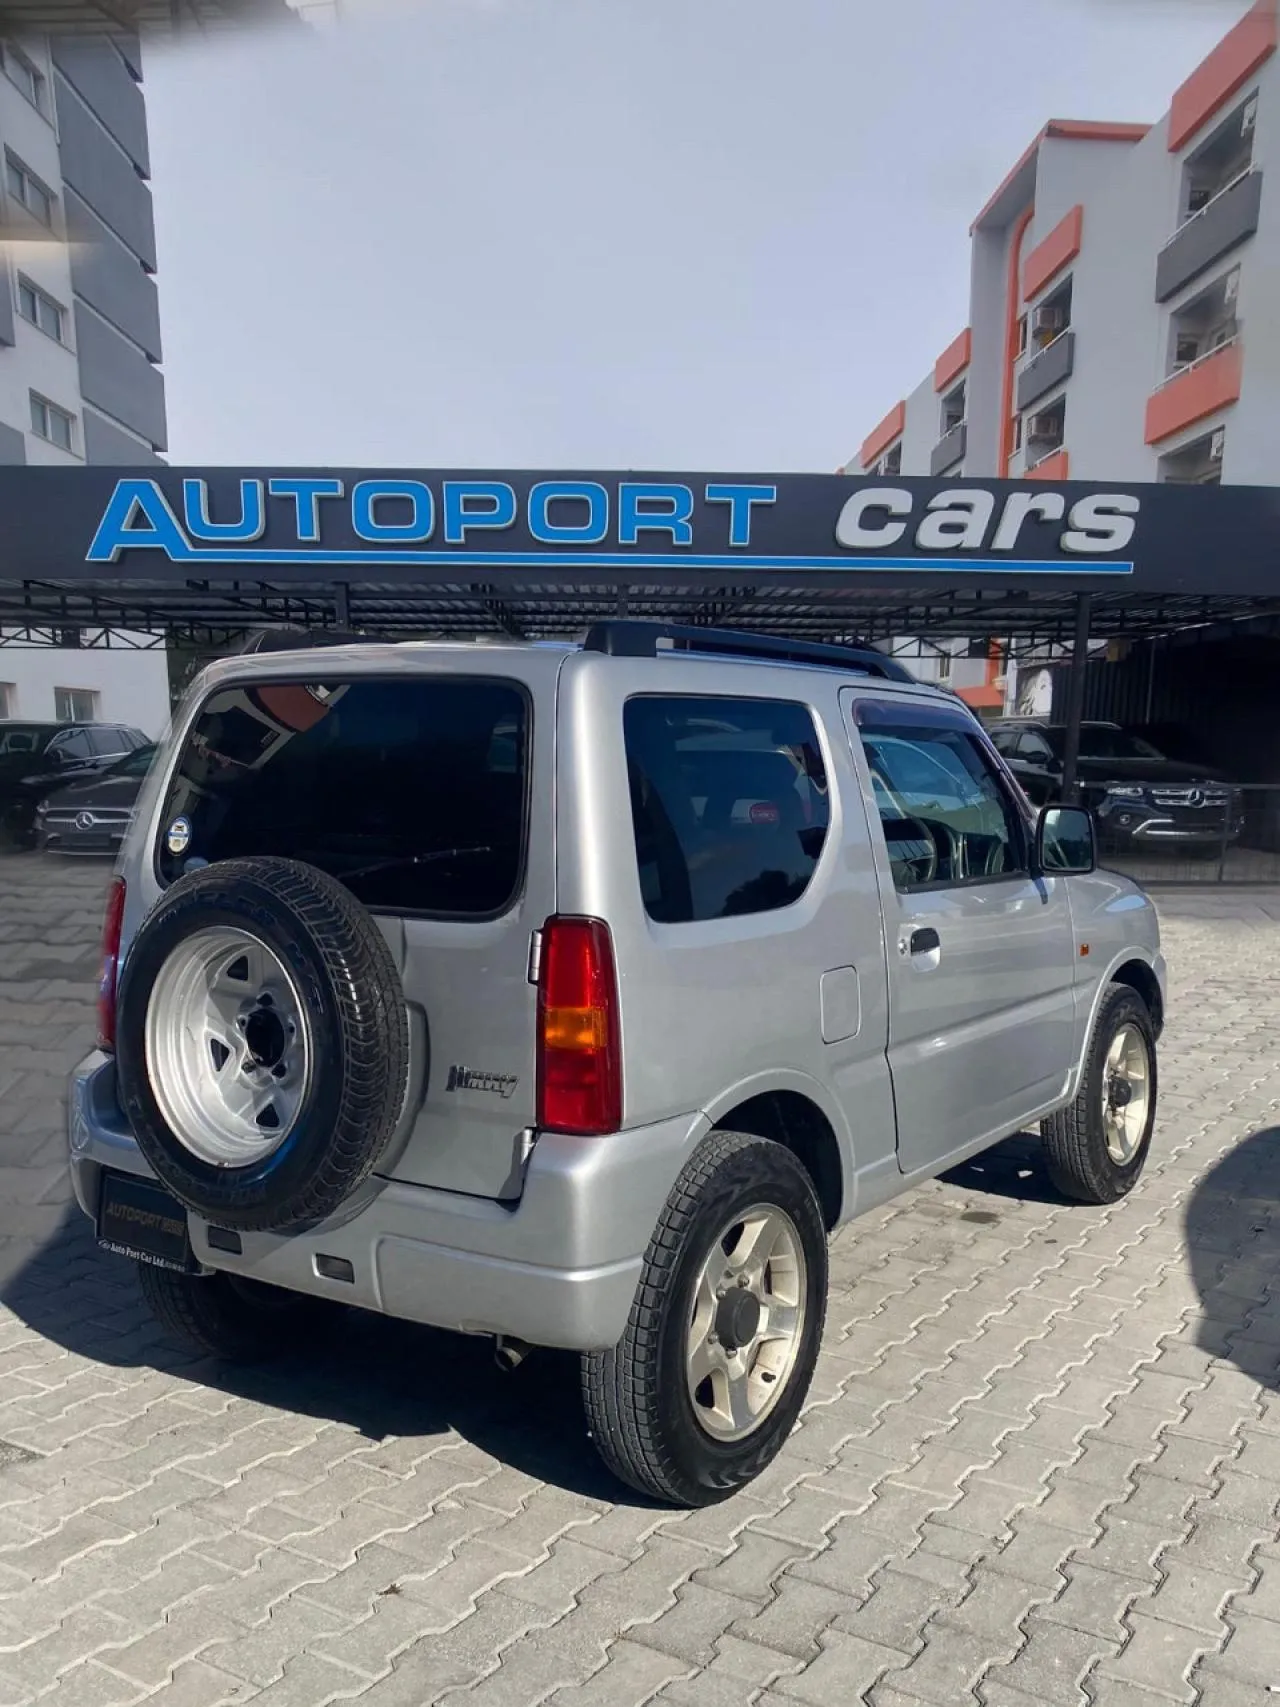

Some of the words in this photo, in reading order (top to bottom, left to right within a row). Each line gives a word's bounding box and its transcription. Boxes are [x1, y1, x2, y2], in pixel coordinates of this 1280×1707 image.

[85, 478, 777, 562] AUTOPORT
[835, 487, 1141, 552] cars
[105, 1201, 162, 1228] AUTOPORT
[110, 1243, 125, 1255] Auto
